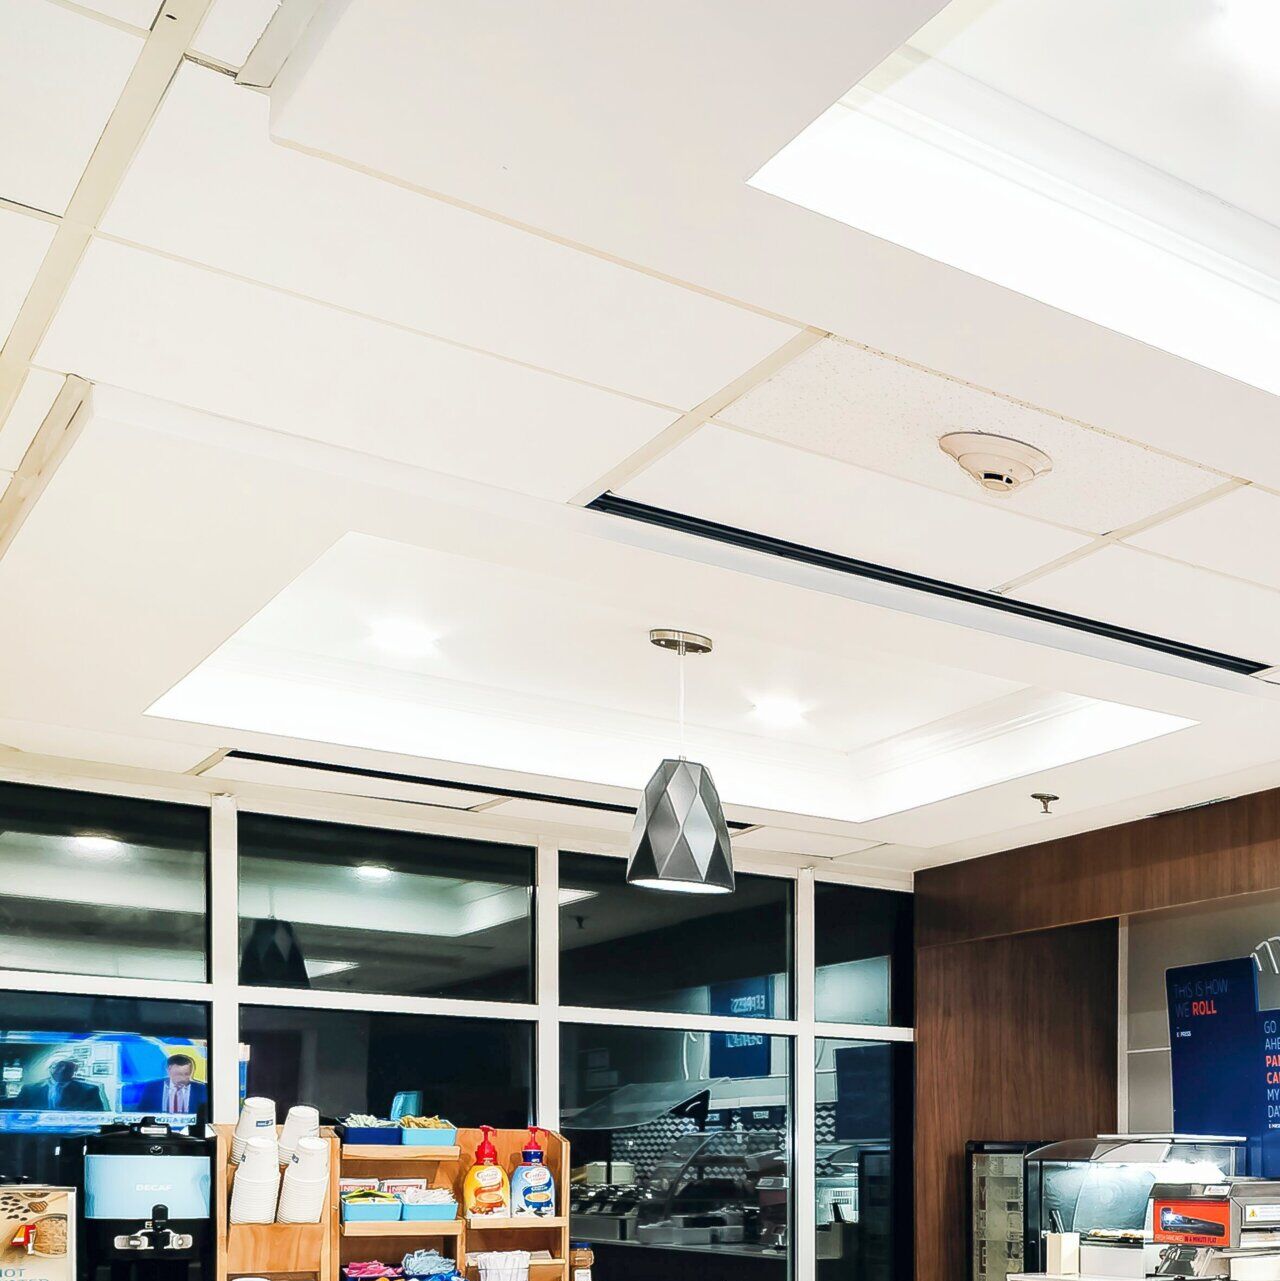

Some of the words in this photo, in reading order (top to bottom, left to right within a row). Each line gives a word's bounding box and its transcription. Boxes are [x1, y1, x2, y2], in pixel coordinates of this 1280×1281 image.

[1173, 983, 1193, 998] THIS
[1195, 981, 1203, 997] IS
[1205, 978, 1228, 995] HOW
[1175, 1002, 1190, 1018] WE
[1192, 1000, 1217, 1016] ROLL
[1264, 1020, 1277, 1034] GO
[1267, 1089, 1280, 1101] MY
[136, 1184, 174, 1193] DECAF
[0, 1268, 25, 1278] OT
